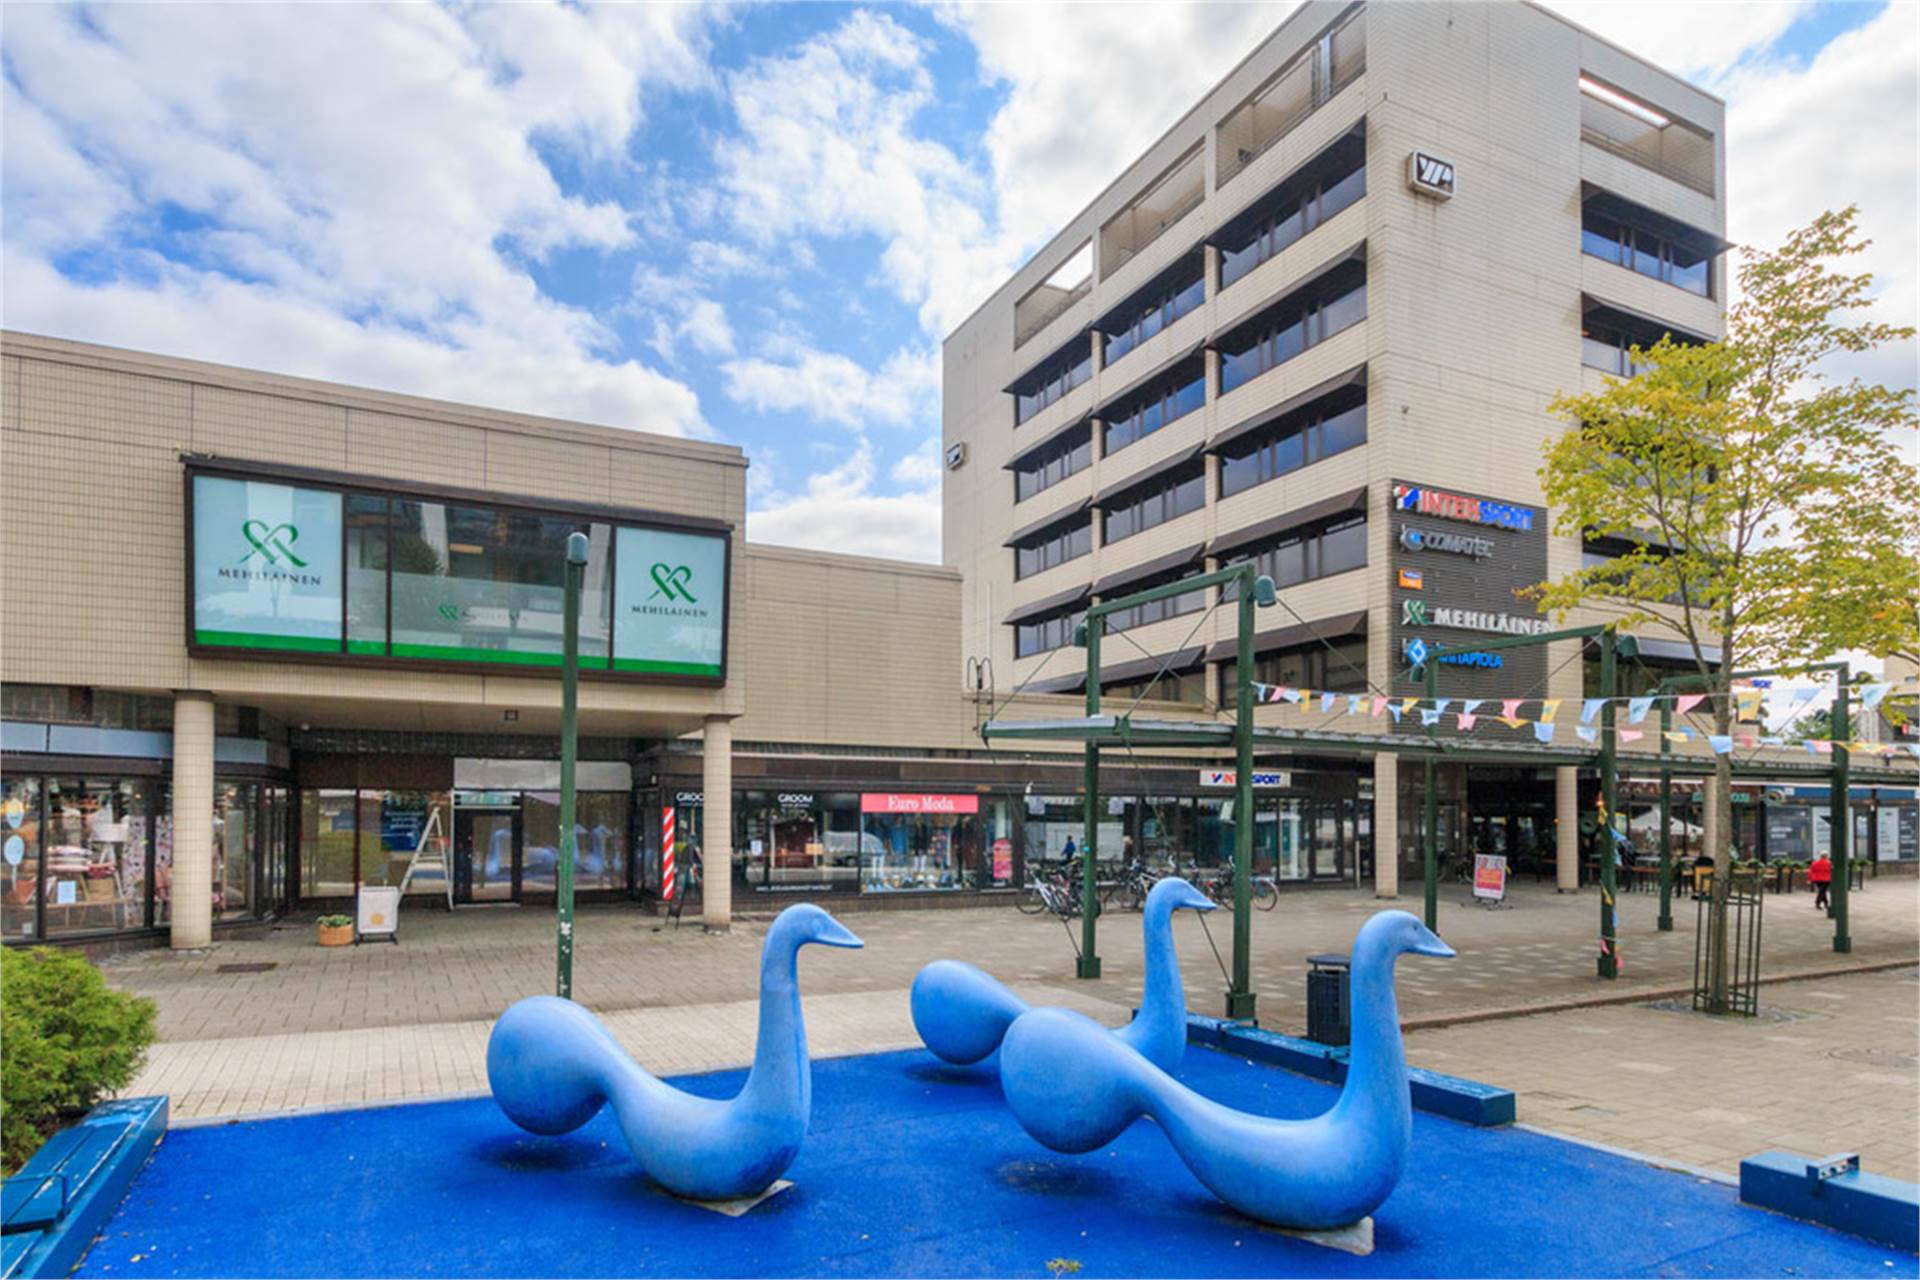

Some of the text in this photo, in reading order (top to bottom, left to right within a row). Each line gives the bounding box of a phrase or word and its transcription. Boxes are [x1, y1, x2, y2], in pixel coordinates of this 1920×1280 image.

[1418, 488, 1534, 531] INTERSPORT
[1424, 531, 1495, 557] COMATEC
[1223, 774, 1281, 784] INTSPORT
[676, 792, 704, 802] GROO
[778, 793, 813, 803] GROOM
[888, 796, 954, 811] Euro Moda
